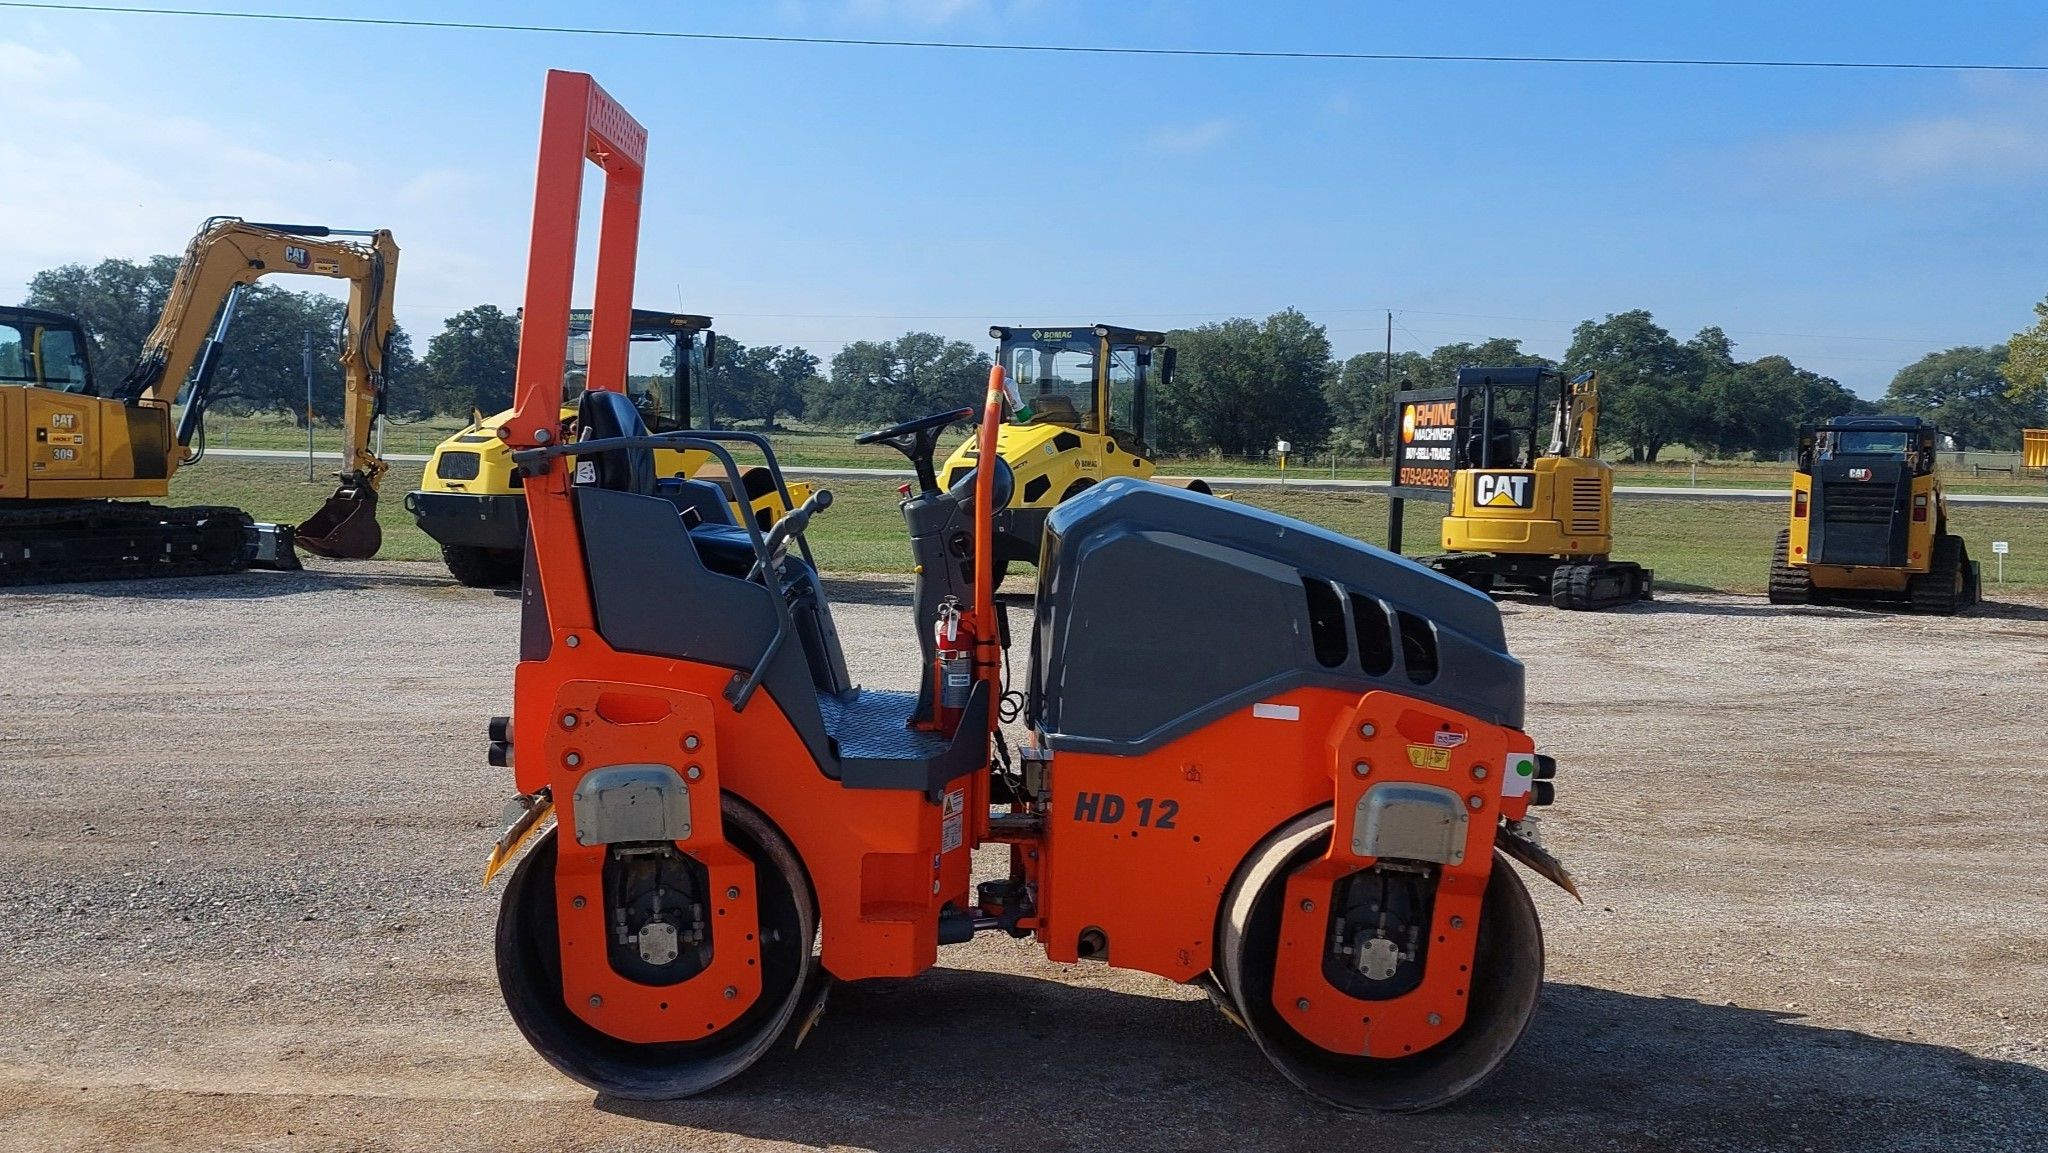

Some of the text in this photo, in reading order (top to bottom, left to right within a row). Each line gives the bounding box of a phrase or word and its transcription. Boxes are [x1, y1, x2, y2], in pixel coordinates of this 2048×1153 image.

[285, 246, 306, 264] CAT
[1043, 331, 1073, 339] BOMAG
[52, 413, 74, 428] CAT
[1414, 427, 1455, 441] MACHINER
[53, 448, 74, 460] 309
[1400, 467, 1452, 488] 979-242-588
[1850, 468, 1867, 479] CAT
[1477, 474, 1529, 507] CAT
[1073, 791, 1180, 830] HD 12
